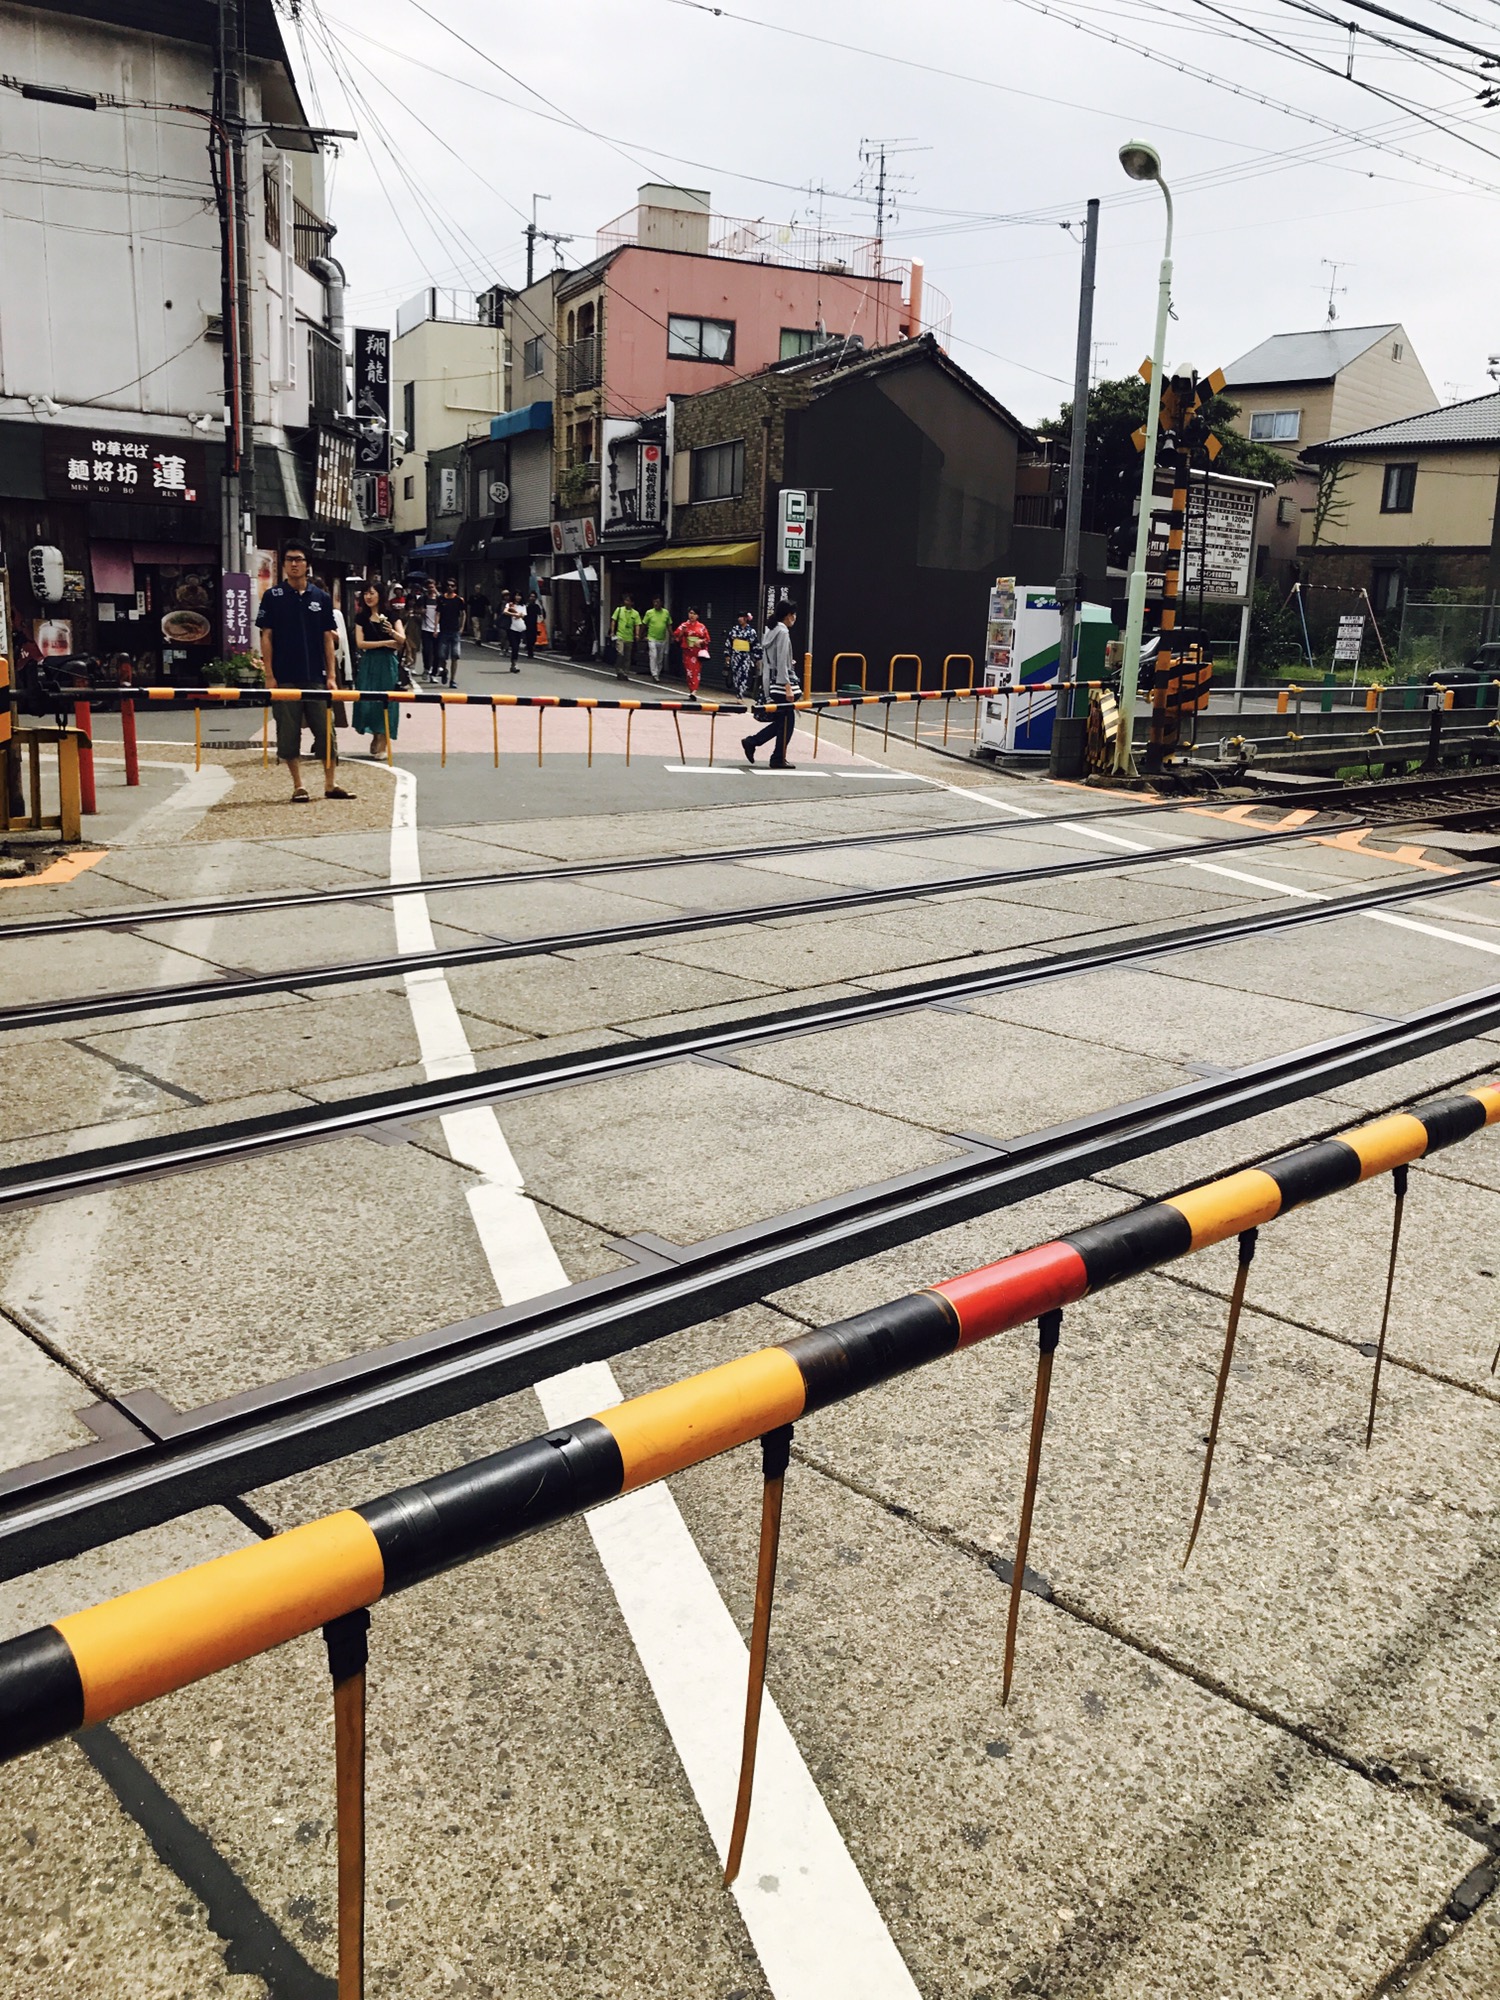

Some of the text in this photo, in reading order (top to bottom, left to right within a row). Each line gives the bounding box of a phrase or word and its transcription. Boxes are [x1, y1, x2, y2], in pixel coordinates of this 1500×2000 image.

[364, 334, 387, 384] 翔龍
[91, 439, 149, 459] 中華そば
[70, 483, 88, 491] MEN
[98, 485, 109, 493] KO
[153, 454, 186, 490] 蓮
[225, 589, 236, 631] あります。
